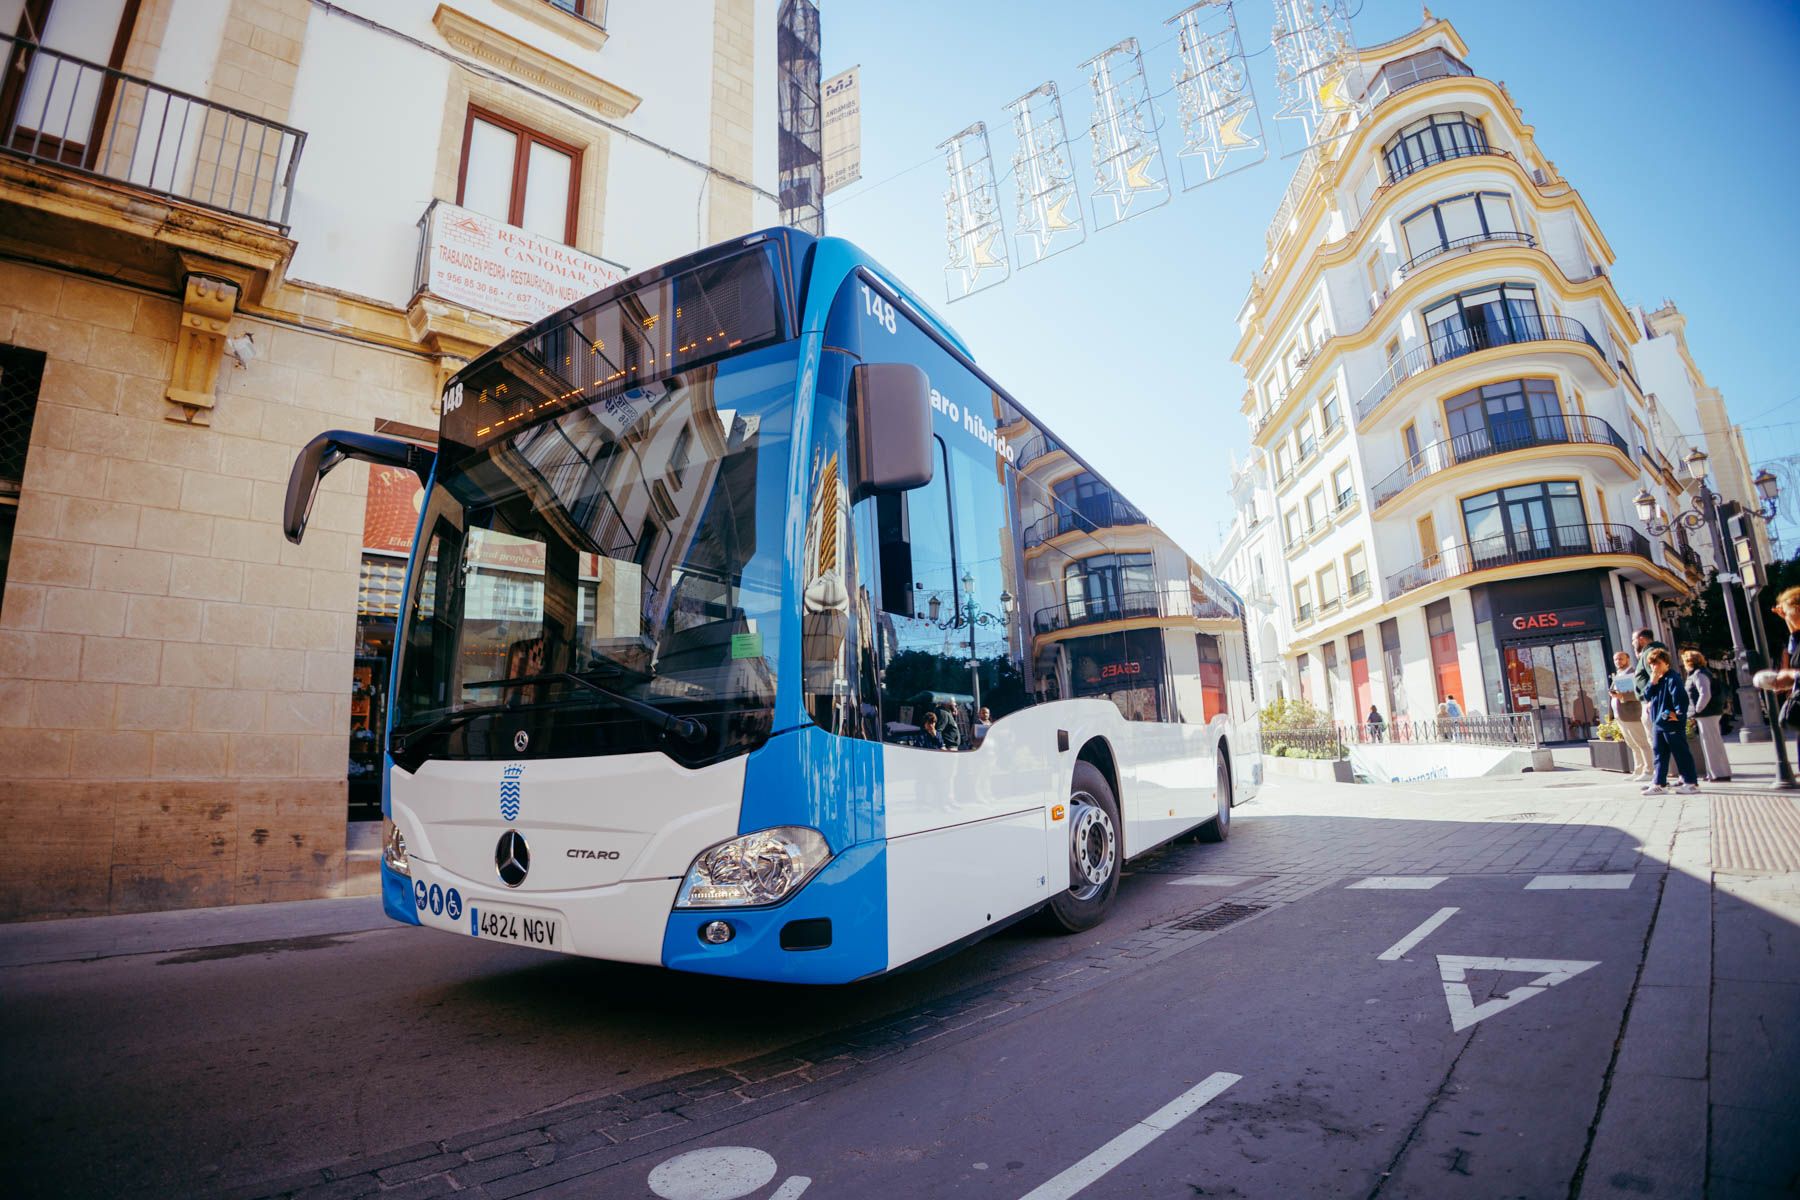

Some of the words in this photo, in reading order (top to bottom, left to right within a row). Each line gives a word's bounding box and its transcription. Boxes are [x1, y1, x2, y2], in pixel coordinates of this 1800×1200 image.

[439, 245, 473, 270] TRABAJOS
[473, 256, 484, 273] EN
[484, 260, 506, 280] PIEDRA
[497, 229, 621, 283] RESTAURACIONES
[447, 271, 462, 284] 956
[861, 285, 897, 334] 148
[442, 382, 464, 416] 148
[931, 388, 959, 423] aro
[388, 536, 413, 548] Elab
[1512, 613, 1559, 630] GAES
[566, 849, 620, 860] CITARO
[481, 912, 518, 939] 4824
[523, 918, 555, 945] NGV
